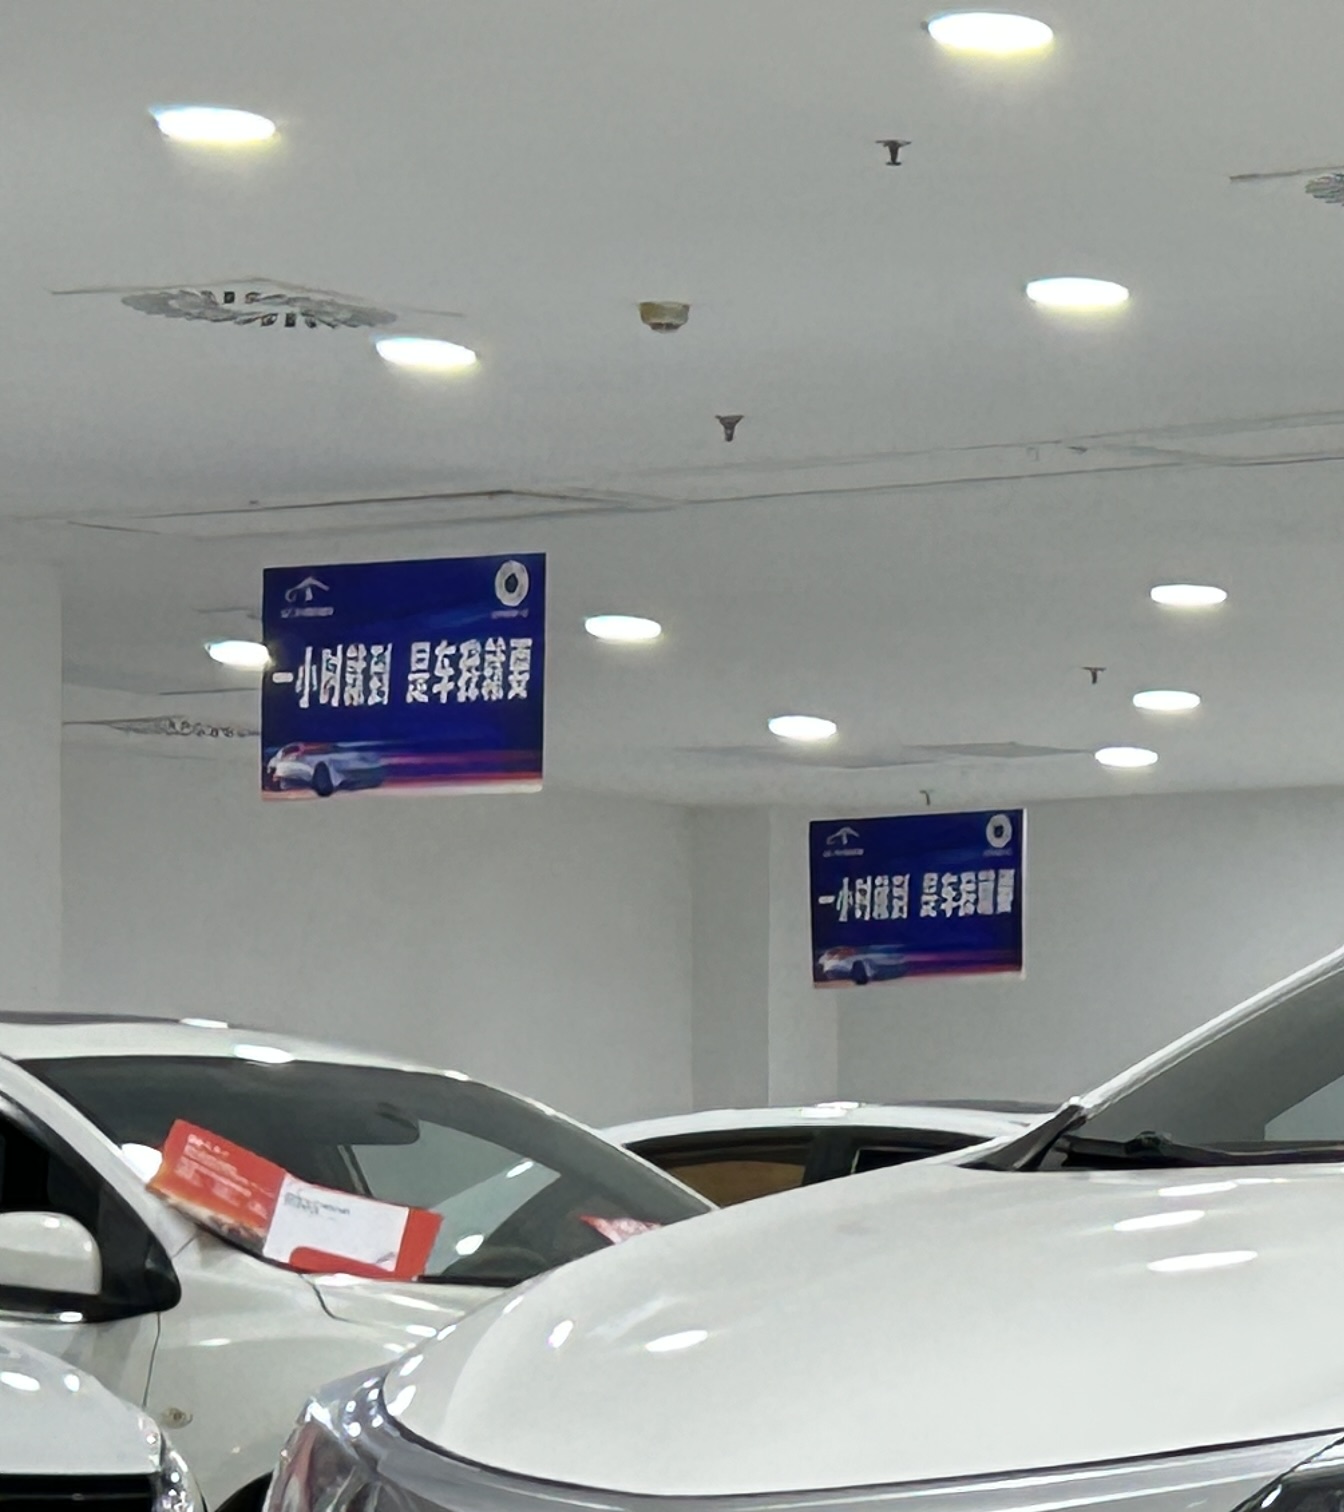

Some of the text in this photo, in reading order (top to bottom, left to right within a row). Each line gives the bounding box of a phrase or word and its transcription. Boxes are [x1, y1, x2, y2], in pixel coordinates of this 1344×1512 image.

[272, 636, 533, 709] 一小时就到 是车我就要
